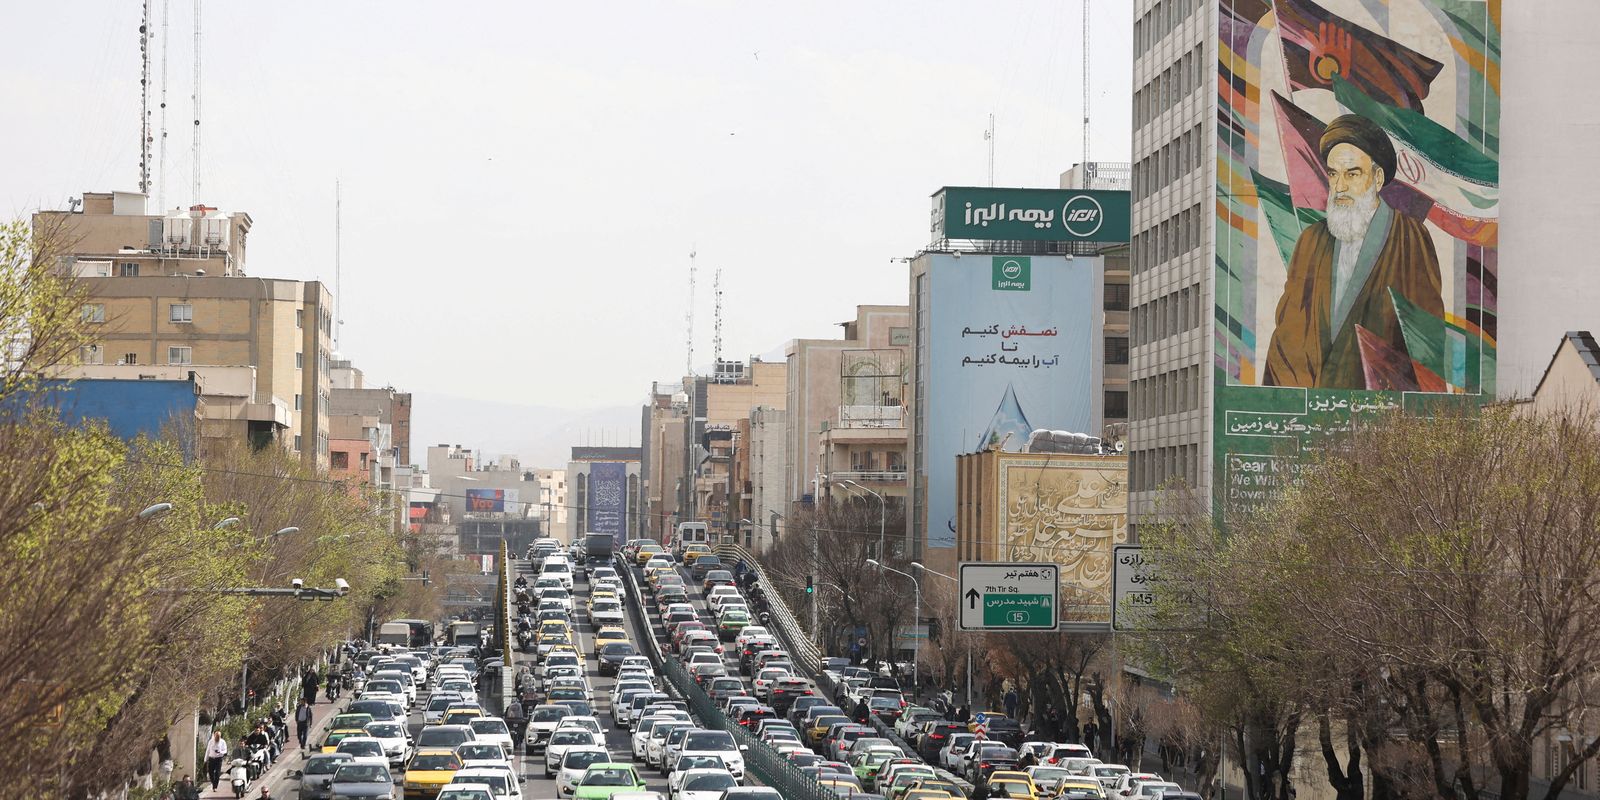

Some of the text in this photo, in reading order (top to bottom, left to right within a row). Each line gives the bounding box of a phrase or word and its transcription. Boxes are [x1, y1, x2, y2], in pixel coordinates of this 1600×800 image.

[965, 202, 1005, 227] البرز
[1009, 209, 1054, 228] بیمه
[962, 324, 1058, 338] نصفش کنیم
[1001, 341, 1018, 351] تا
[962, 354, 1059, 368] آب را بیمه کنیم
[1231, 417, 1263, 432] زمین
[1264, 420, 1279, 433] به
[1231, 458, 1267, 473] Dear
[1231, 474, 1251, 486] We
[1004, 570, 1039, 580] هفتم تیر
[986, 597, 1039, 607] شهید مدرس
[1012, 613, 1023, 621] 15
